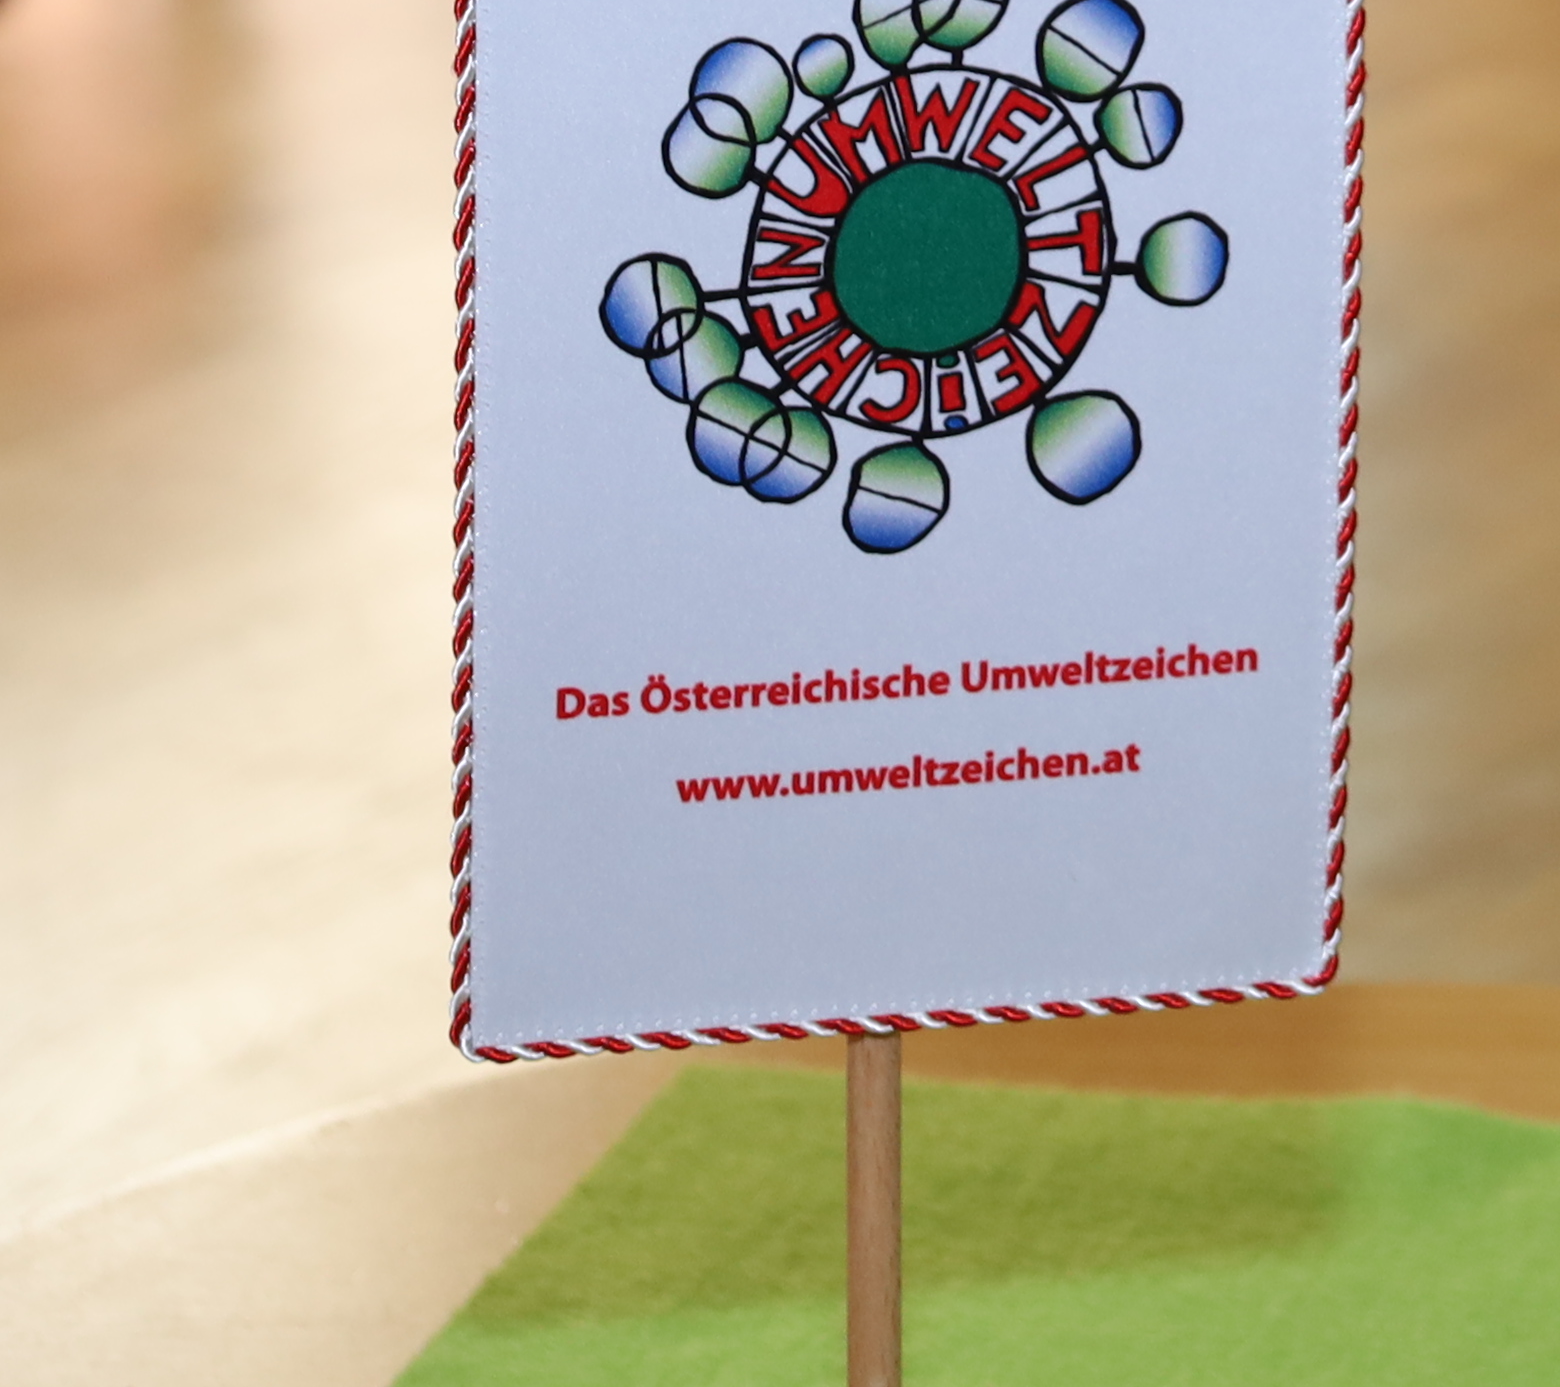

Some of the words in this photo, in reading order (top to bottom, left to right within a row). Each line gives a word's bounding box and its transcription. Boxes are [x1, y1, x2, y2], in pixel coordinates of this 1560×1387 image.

[555, 686, 630, 720] Das
[640, 663, 951, 715] Österreichische
[961, 643, 1259, 694] Umweltzeichen
[676, 742, 1141, 803] www.umweltzeichen.at
